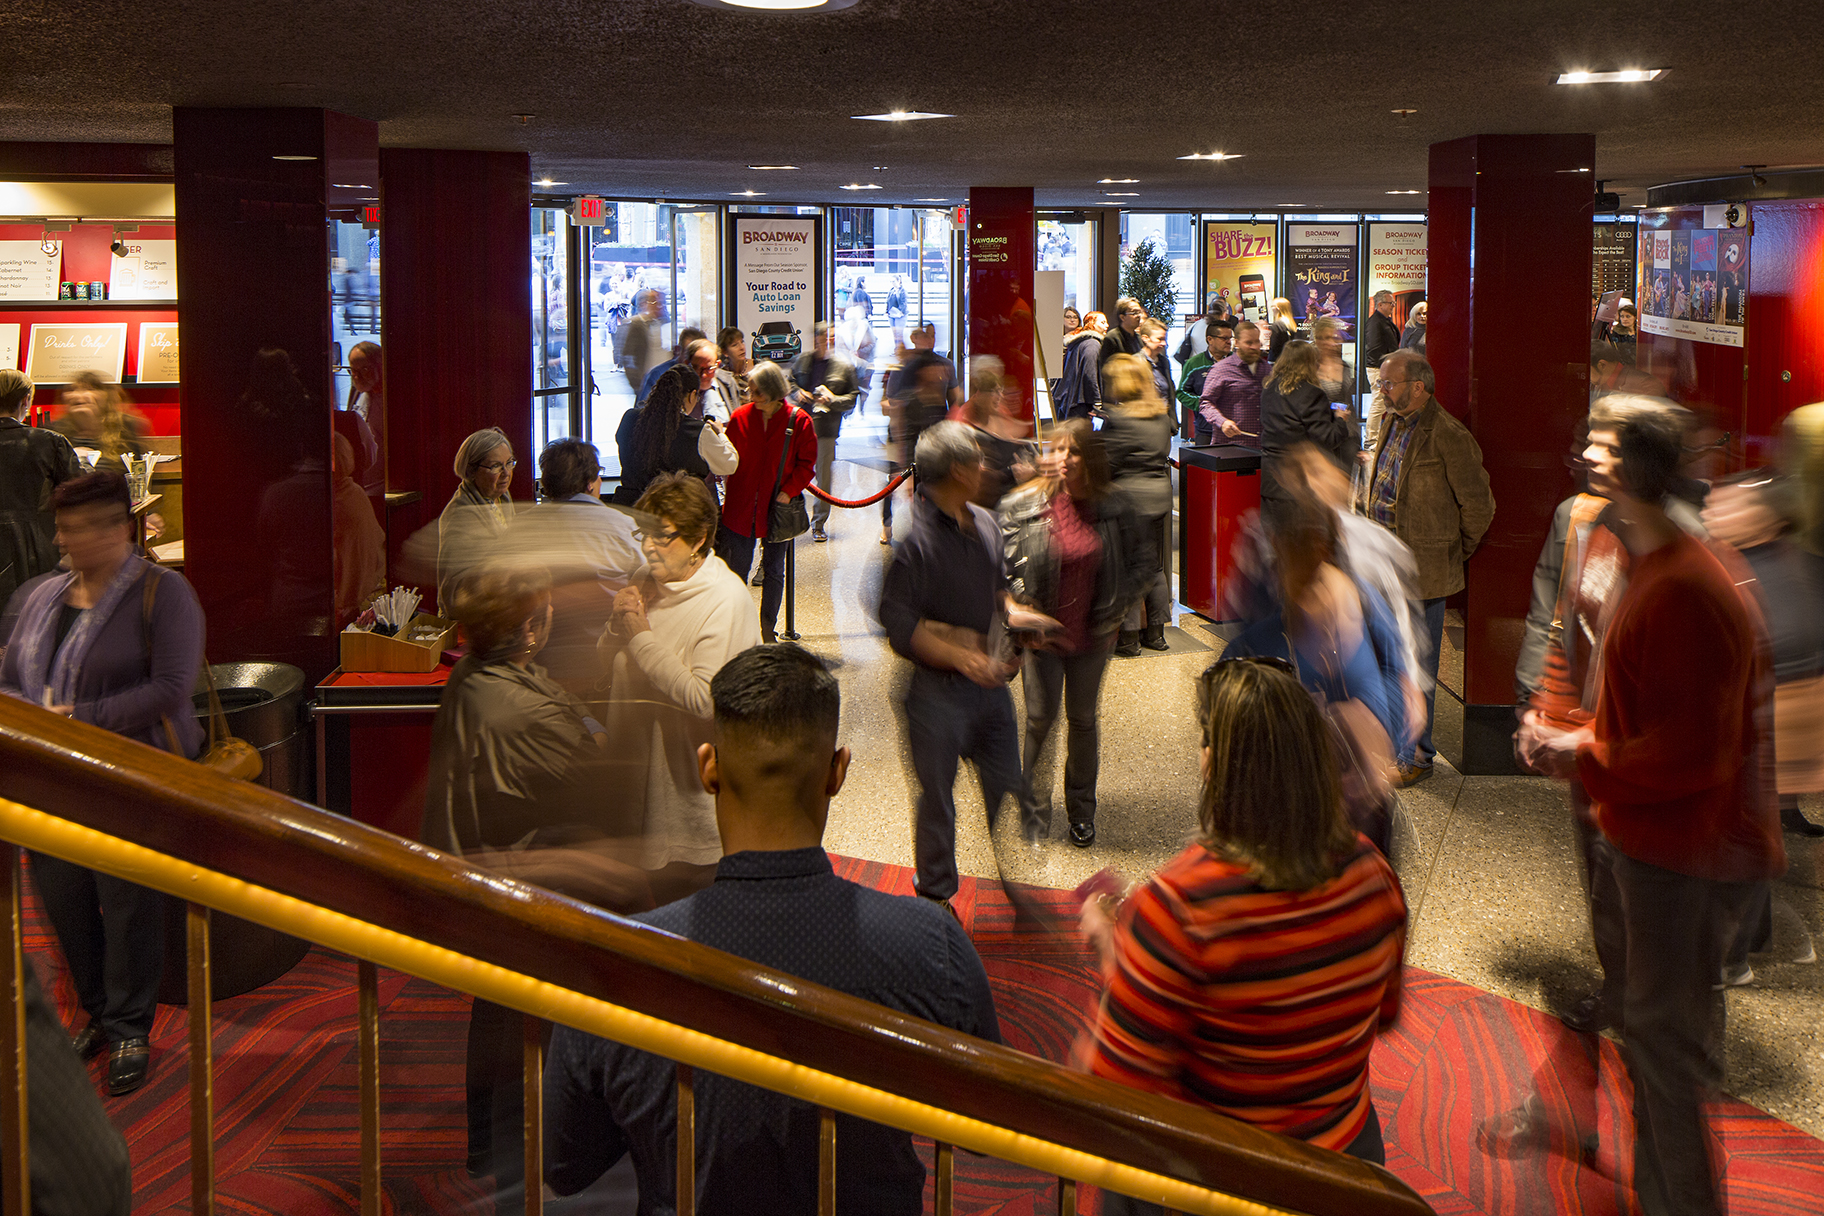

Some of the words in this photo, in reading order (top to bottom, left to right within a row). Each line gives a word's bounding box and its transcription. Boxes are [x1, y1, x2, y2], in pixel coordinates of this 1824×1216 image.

[581, 199, 602, 218] EXIT
[743, 231, 809, 244] BROADWAY
[1210, 230, 1242, 242] SHARE
[1215, 237, 1272, 260] BUZZ!
[1295, 272, 1307, 281] The
[1304, 267, 1331, 285] King
[1331, 272, 1342, 280] and
[1342, 269, 1350, 282] I
[746, 282, 769, 291] Your
[771, 281, 794, 290] Road
[796, 282, 806, 290] to
[752, 293, 776, 301] Auto
[778, 292, 801, 301] Loan
[758, 303, 795, 313] Savings
[45, 335, 76, 348] Drinks
[81, 334, 113, 355] Only!
[151, 332, 172, 351] Skip
